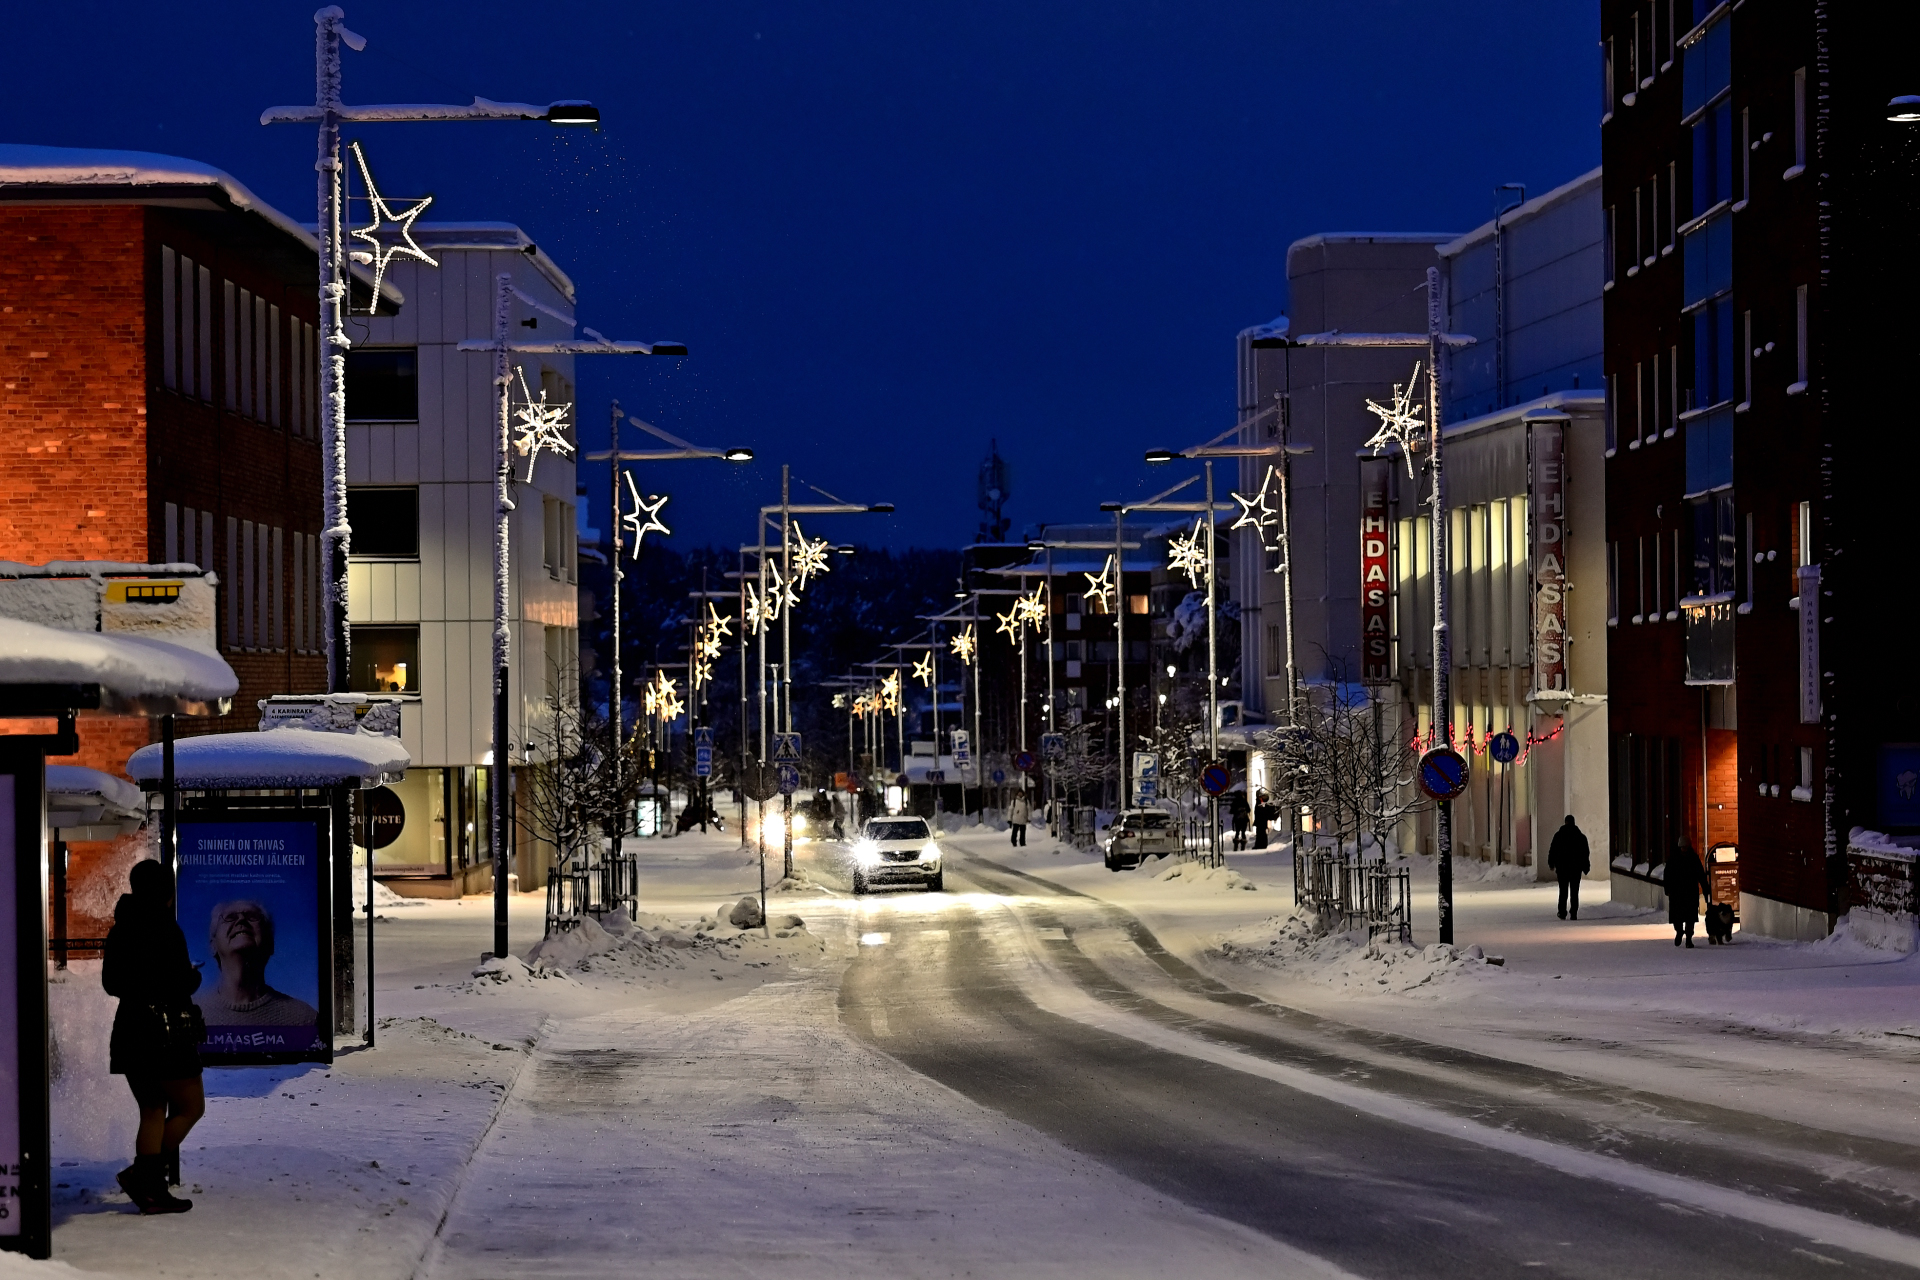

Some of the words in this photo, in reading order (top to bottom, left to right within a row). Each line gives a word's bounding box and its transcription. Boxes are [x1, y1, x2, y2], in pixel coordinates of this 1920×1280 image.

[1537, 432, 1562, 691] TEHDASASU
[197, 838, 236, 851] SININEN
[237, 838, 250, 851] ON
[252, 838, 285, 851] TAIVAS
[177, 853, 265, 866] KAIHILEIKKAUKSEN
[266, 852, 305, 866] JÄLKEEN
[203, 1031, 286, 1046] LMÄASEMA
